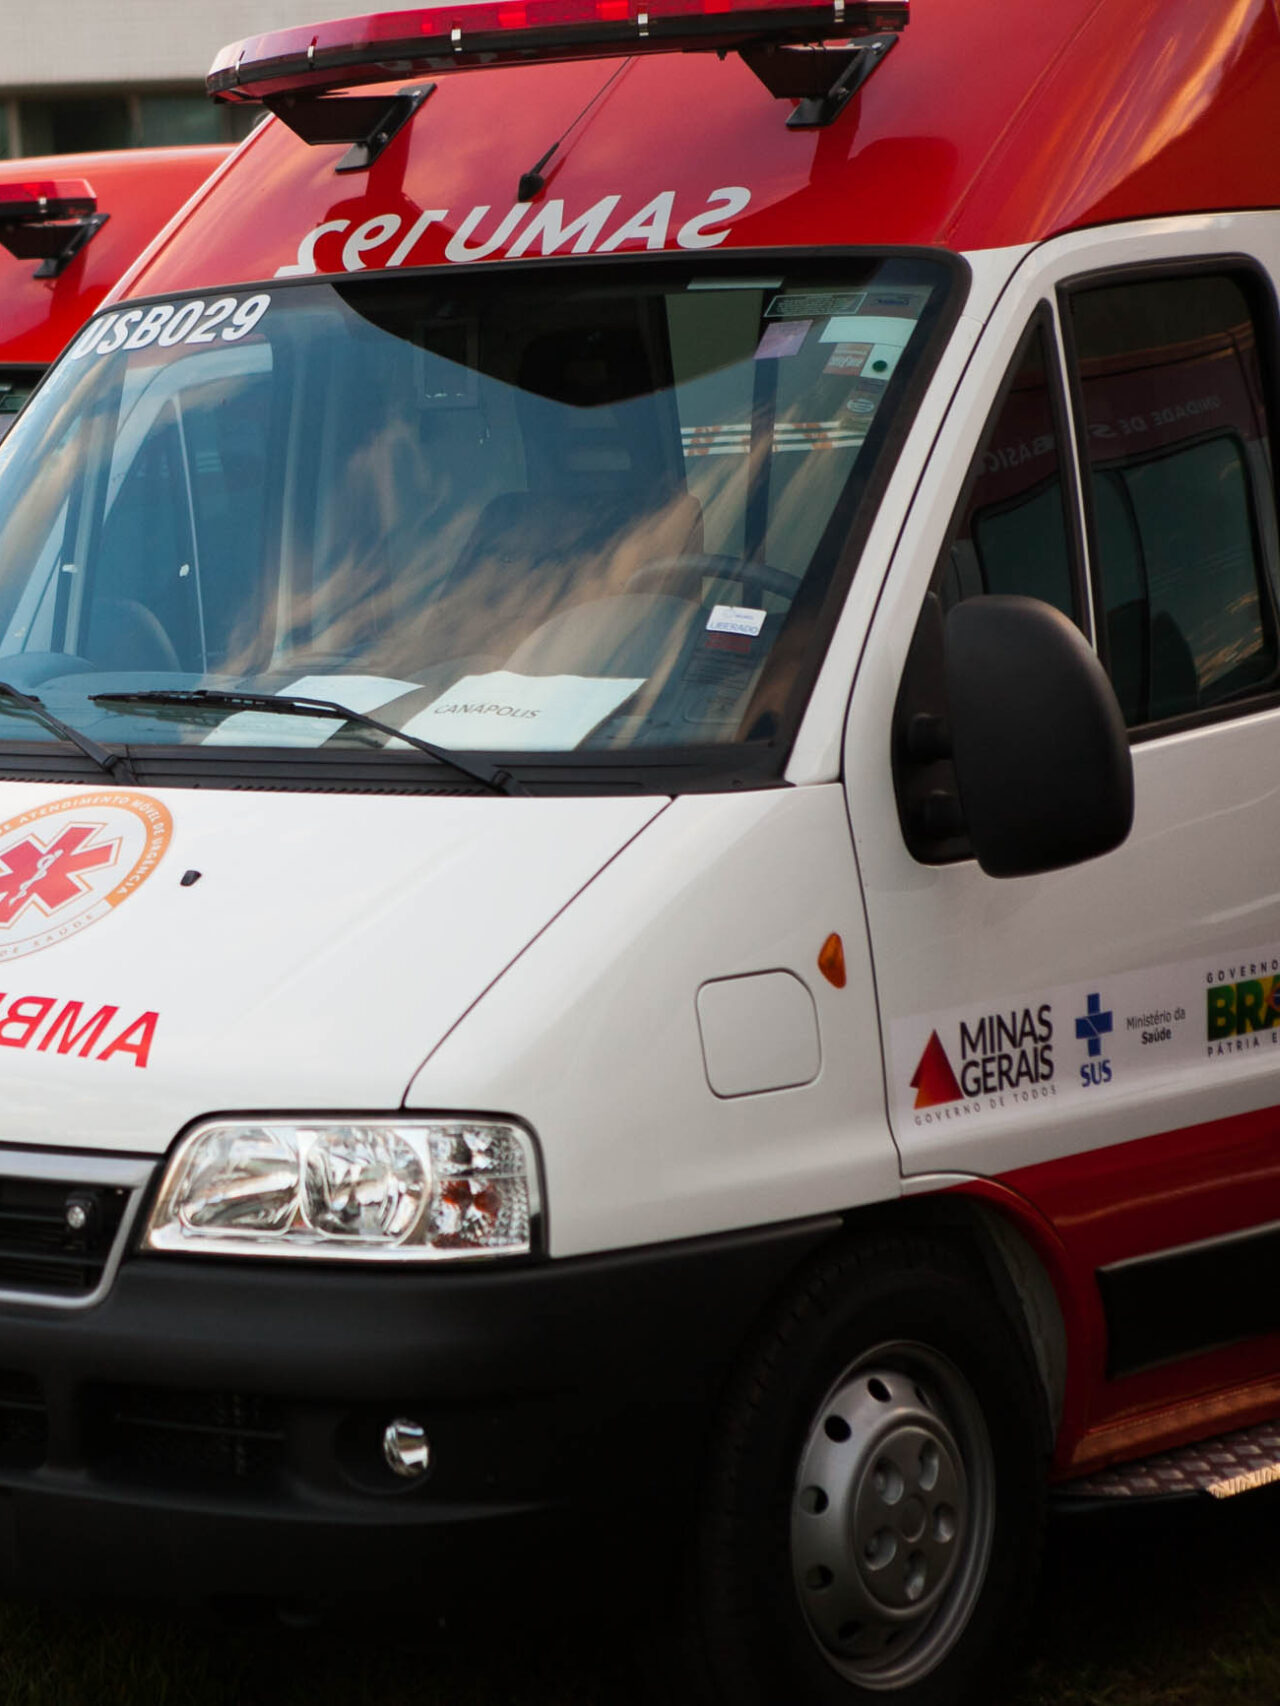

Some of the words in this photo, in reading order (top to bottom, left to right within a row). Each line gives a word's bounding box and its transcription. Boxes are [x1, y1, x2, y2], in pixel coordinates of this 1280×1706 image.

[70, 293, 272, 361] USB029
[1207, 959, 1278, 984] GOVERNO
[960, 1003, 1053, 1060] MINAS
[1126, 1009, 1173, 1031] Ministério
[1174, 1007, 1186, 1022] da
[1141, 1027, 1172, 1045] Saúde
[961, 1044, 1055, 1098] GERAIS
[1080, 1059, 1113, 1088] SUS
[914, 1102, 982, 1126] GOVERNO
[990, 1096, 1005, 1110] DE
[1014, 1084, 1057, 1103] TODOS
